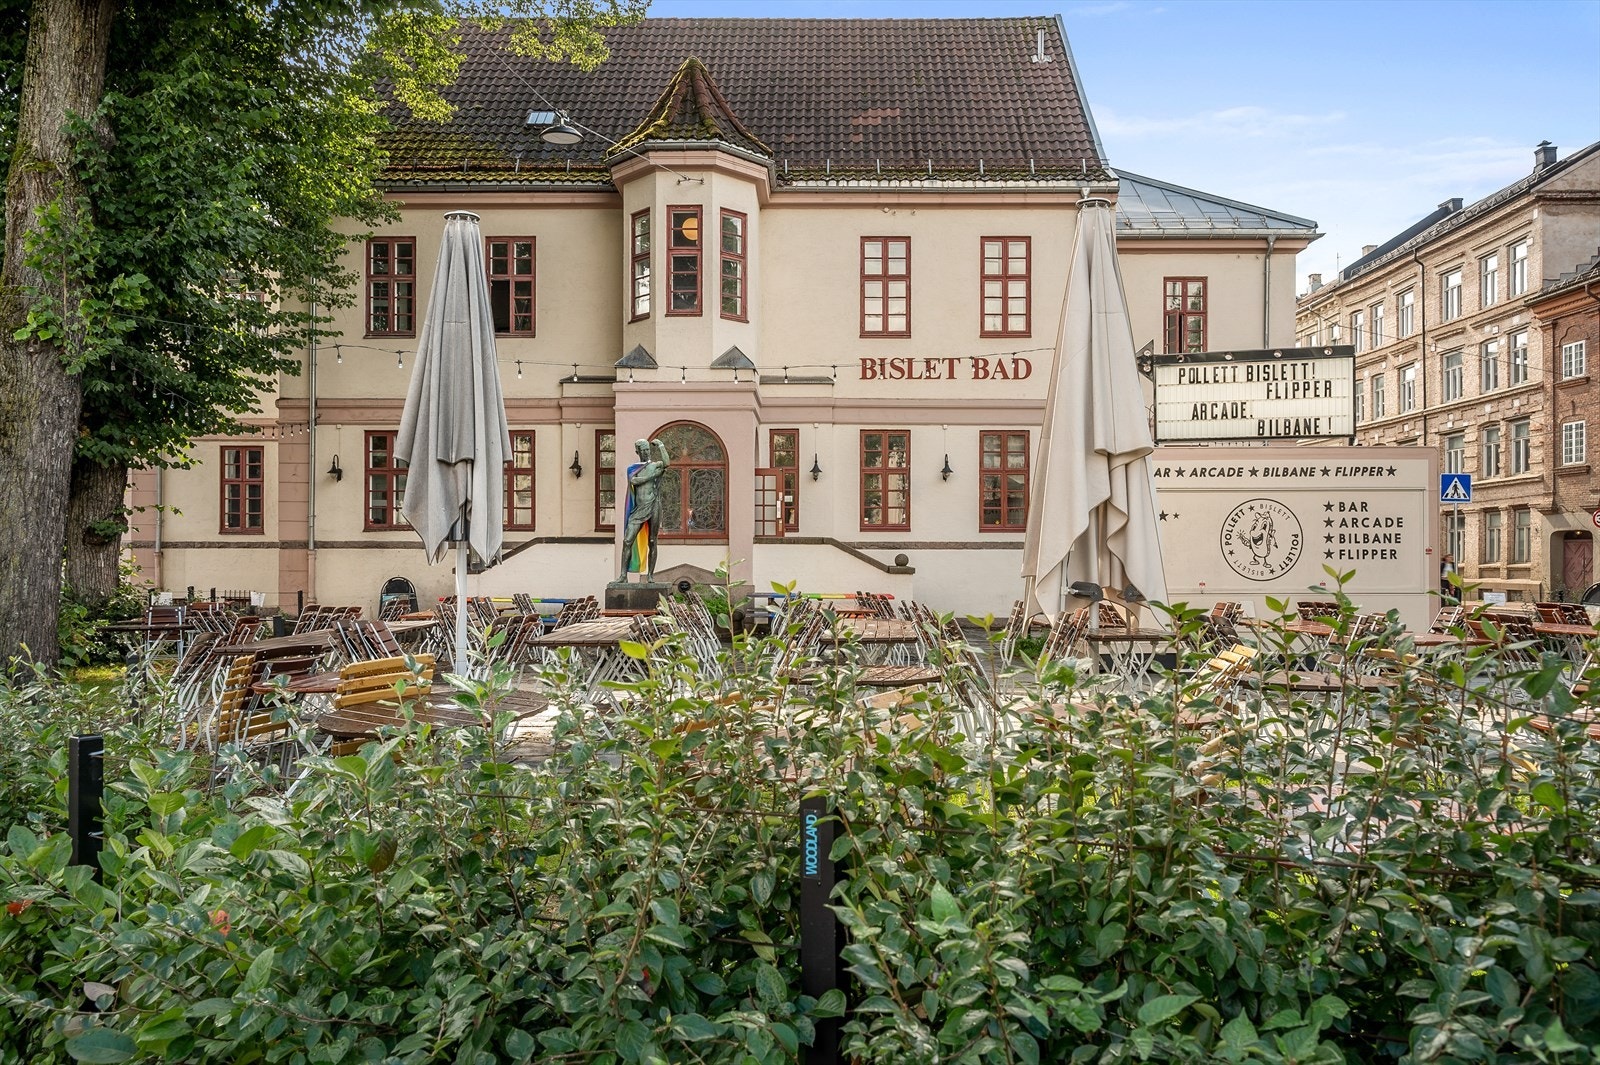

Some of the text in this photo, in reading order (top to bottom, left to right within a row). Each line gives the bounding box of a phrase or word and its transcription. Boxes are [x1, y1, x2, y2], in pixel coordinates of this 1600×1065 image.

[859, 357, 1033, 380] BISLET BAD
[1178, 362, 1316, 384] POLLETT BISLETT!
[1266, 380, 1332, 400] FLIPPER
[1153, 466, 1384, 478] AR ARCADE BILBANE FLIPPER
[1260, 503, 1290, 521] BISLETT
[1338, 501, 1369, 513] BAR
[1224, 508, 1246, 547] POLLETT
[1338, 517, 1404, 529] ARCADE
[1338, 533, 1402, 545] BILBANE
[1278, 533, 1299, 572] POLLETT
[1338, 549, 1398, 560] FLIPPER
[1233, 560, 1265, 577] BISLETT
[805, 814, 818, 875] WOODLAND
